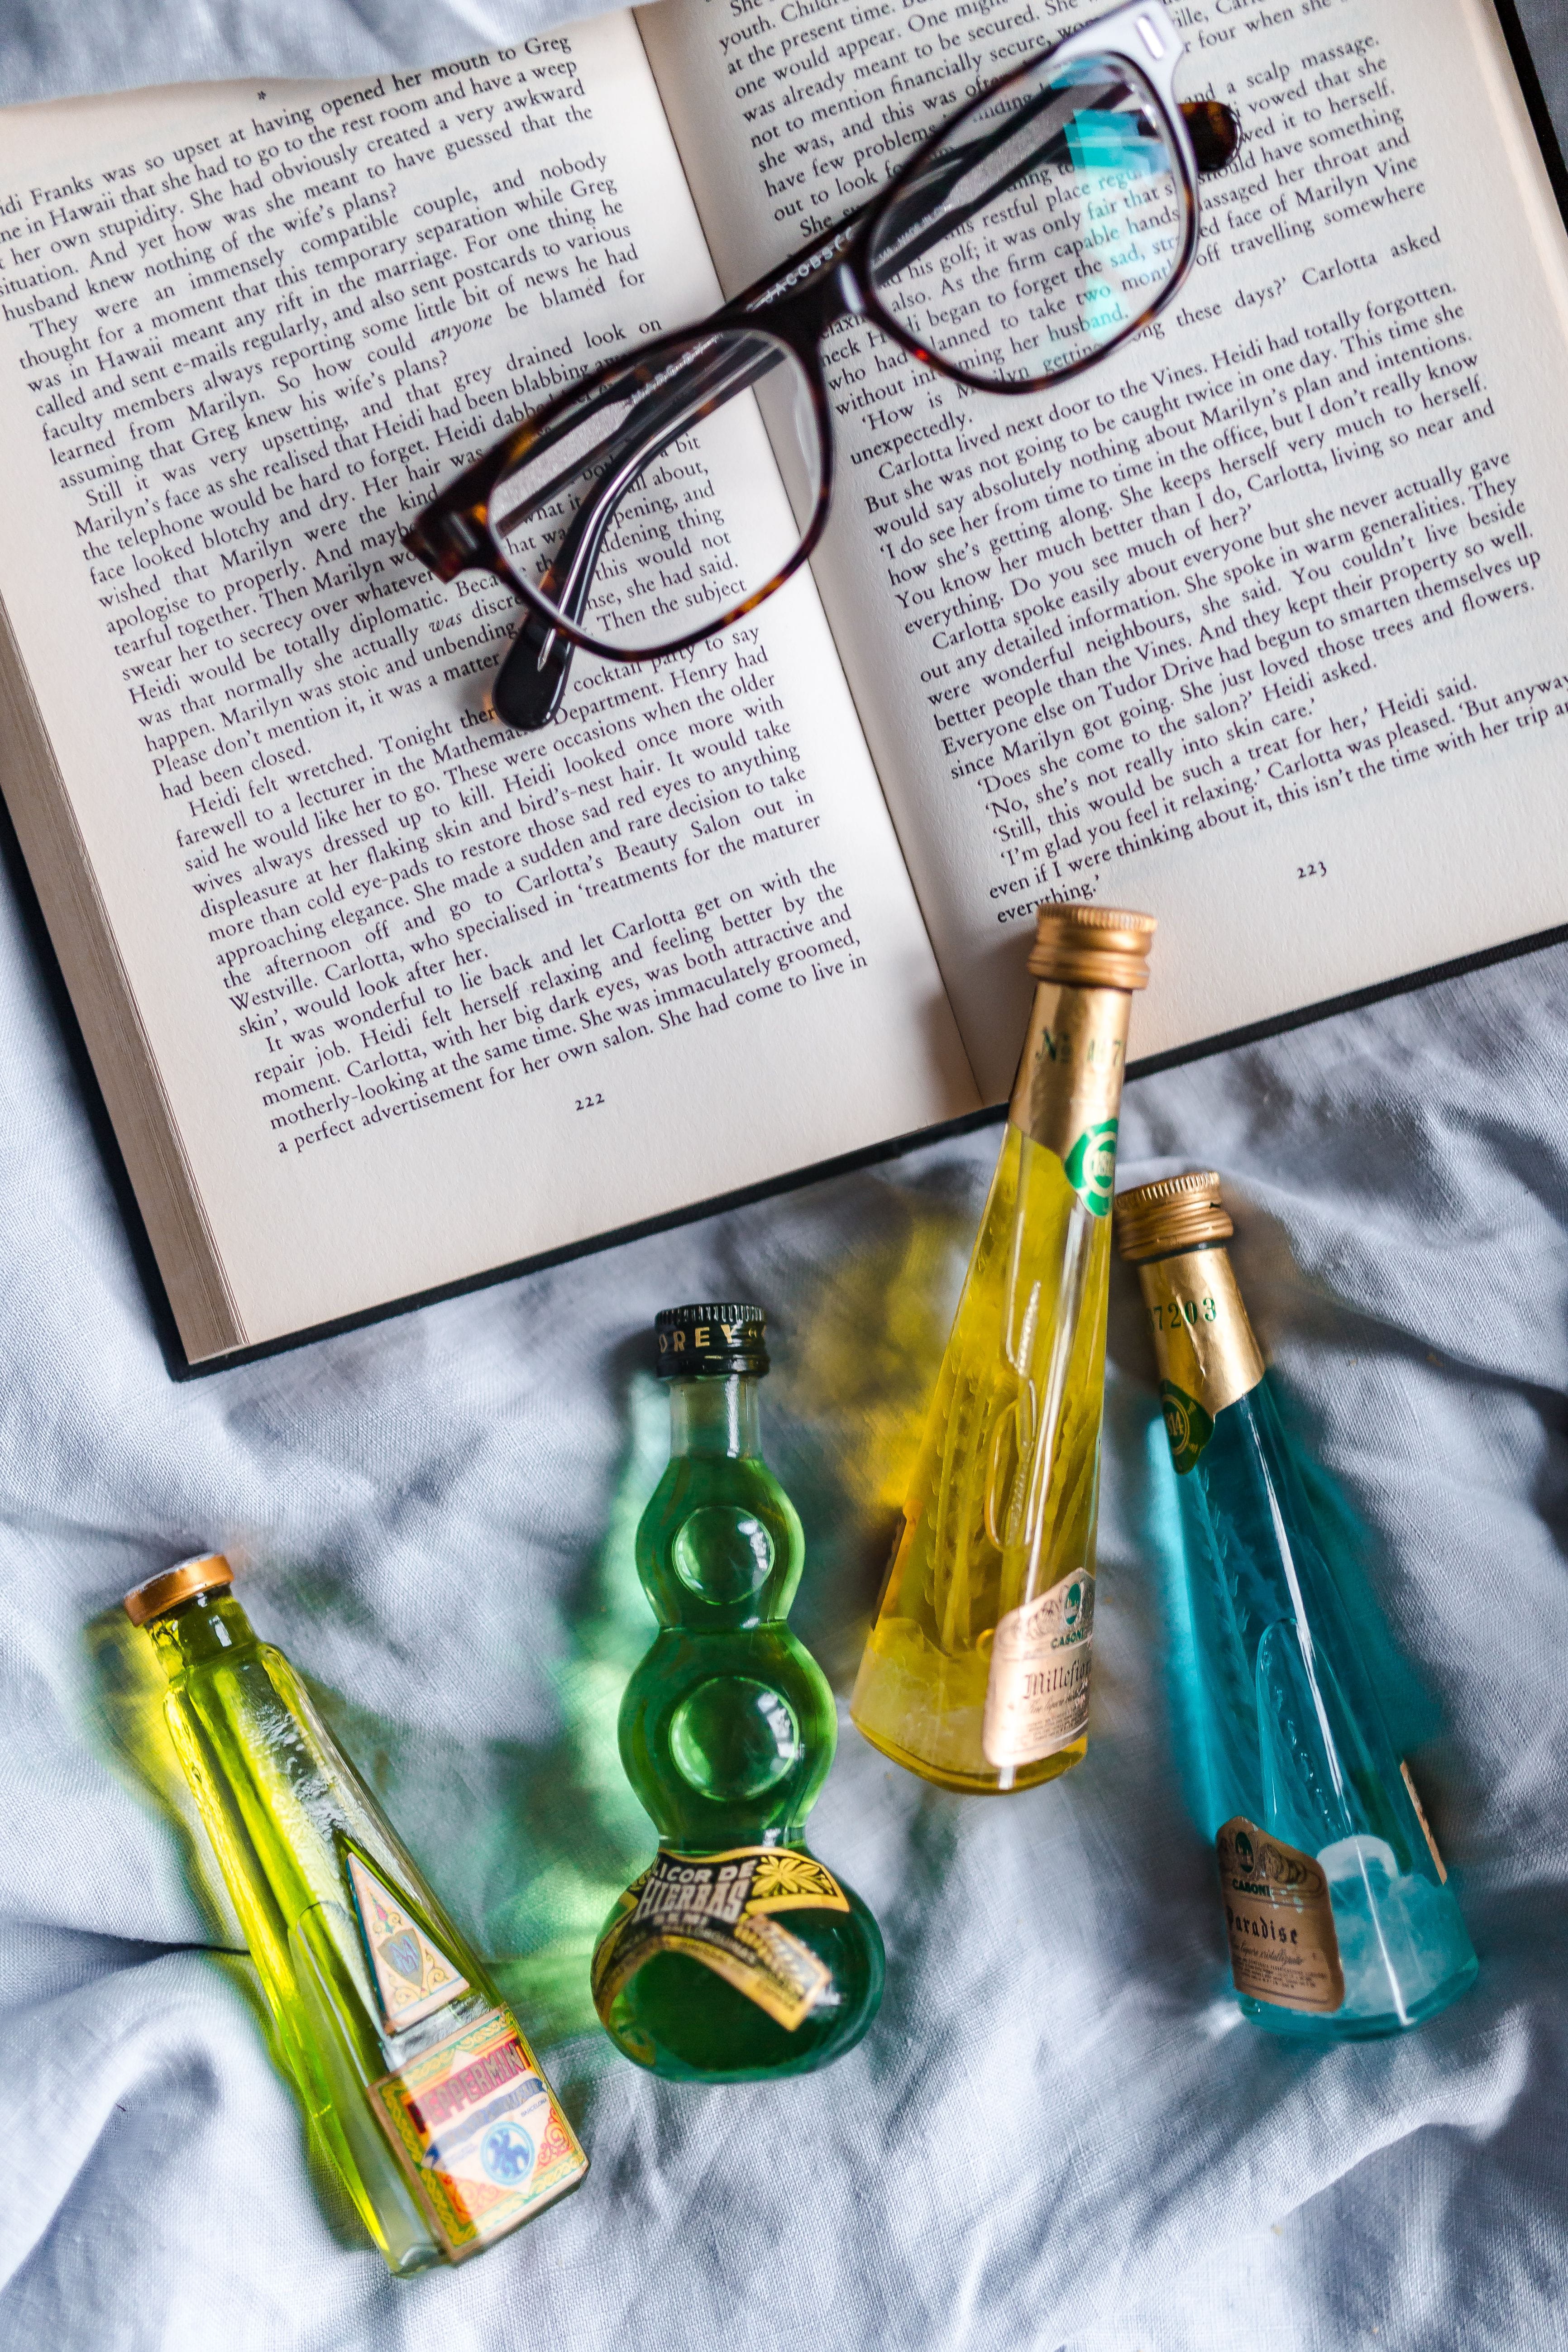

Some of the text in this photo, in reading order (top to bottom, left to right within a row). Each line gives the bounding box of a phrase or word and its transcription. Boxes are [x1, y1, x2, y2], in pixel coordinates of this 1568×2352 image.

[30, 37, 572, 206] Franks was so upset at having opened her mouth to Greg
[750, 34, 1052, 149] not to mention financially secure,
[29, 151, 606, 338] They were an immensely compatible couple, and nobody
[893, 292, 932, 318] also.
[942, 277, 965, 296] As
[971, 265, 1000, 285] the
[1007, 252, 1047, 273] firm
[1054, 226, 1120, 258] capable
[1176, 303, 1222, 327] these
[1302, 253, 1378, 286] Carlotta
[1391, 225, 1442, 258] asked
[1196, 182, 1426, 267] off travelling somewhere
[49, 269, 645, 466] learned from Marilyn. So how could anyone be blamed for
[86, 320, 662, 507] Still it was very upsetting, and that grey drained look on
[878, 282, 1457, 480] Carlotta lived next door to the Vines. Heidi had totally forgotten.
[596, 579, 747, 632] Then the subject
[932, 453, 1511, 650] Carlotta spoke easily about everyone but she never actually gave
[185, 672, 775, 872] said he would like her to go. These were occasions when the older
[1039, 754, 1069, 776] she
[1076, 738, 1125, 763] come
[1131, 730, 1151, 745] to
[1158, 715, 1187, 736] the
[1262, 671, 1315, 703] Heidi
[1322, 652, 1377, 684] asked.
[1047, 802, 1081, 827] this
[1087, 778, 1146, 812] would
[1150, 773, 1175, 792] be
[1182, 754, 1224, 783] such
[1231, 754, 1241, 767] a
[1248, 737, 1290, 761] treat
[1296, 726, 1322, 746] for
[1377, 687, 1429, 719] Heidi
[1437, 673, 1477, 701] said.
[228, 973, 318, 1011] Westville.
[325, 950, 405, 981] Carlotta,
[410, 932, 449, 954] who
[456, 894, 550, 943] specialised
[554, 890, 574, 908] in
[684, 847, 710, 866] for
[717, 835, 746, 856] the
[752, 815, 820, 846] maturer
[1297, 860, 1328, 880] 223
[278, 952, 868, 1154] a perfect advertisement for her own salon. She had come to live in
[575, 1092, 606, 1112] 222
[631, 1877, 752, 1925] HIERBAS
[718, 1859, 758, 1882] DE
